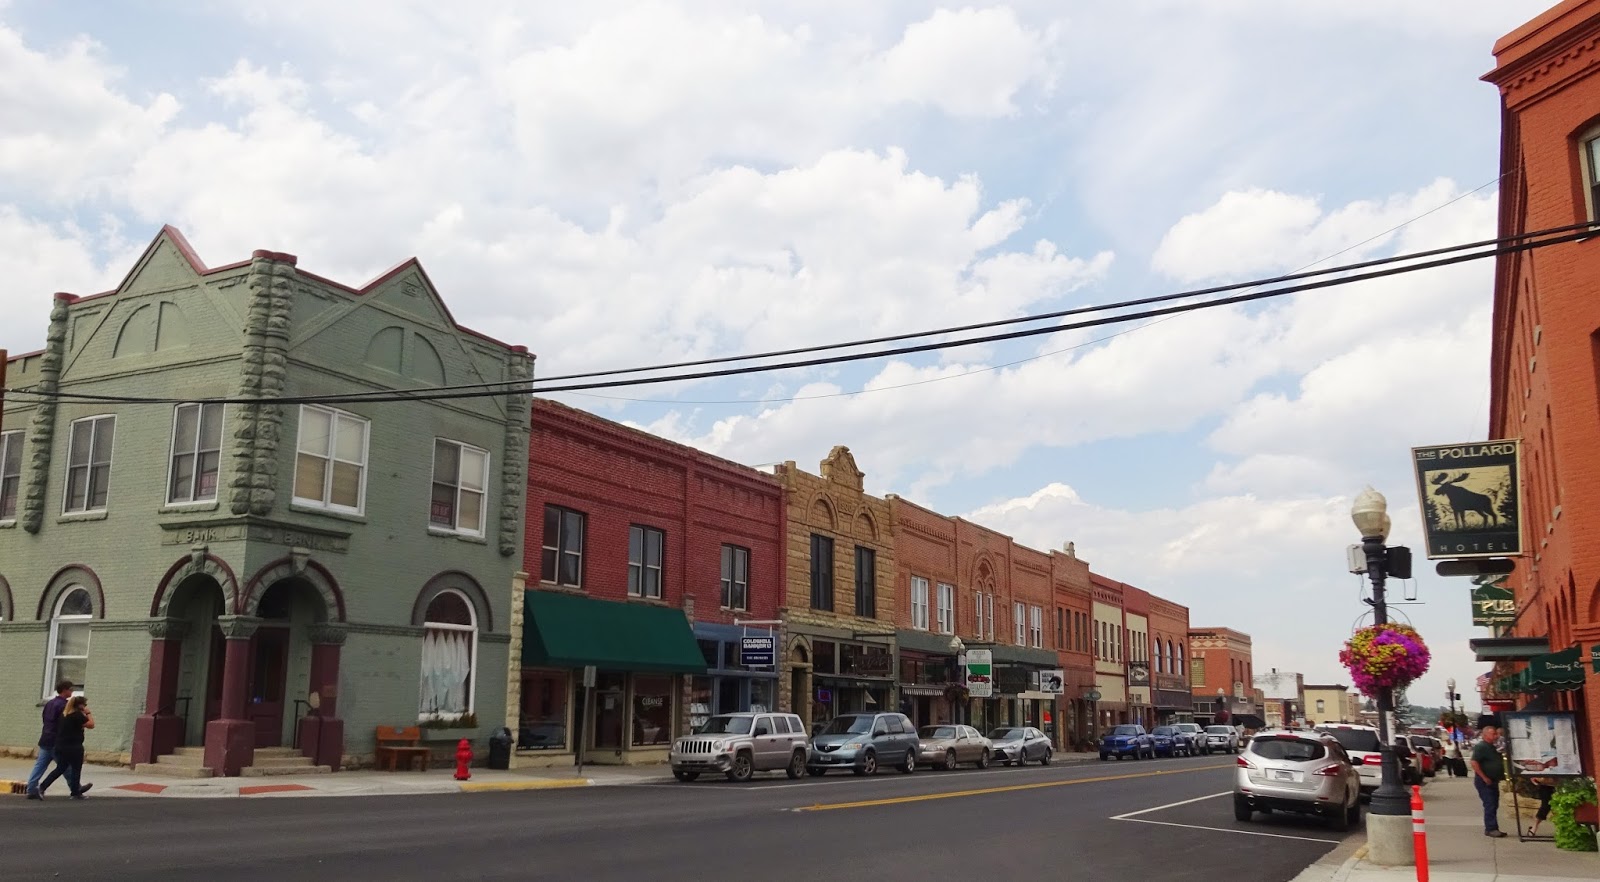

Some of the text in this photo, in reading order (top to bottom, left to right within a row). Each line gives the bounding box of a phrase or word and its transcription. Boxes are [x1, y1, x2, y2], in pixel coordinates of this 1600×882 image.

[1440, 444, 1515, 459] POLLARD
[186, 530, 216, 541] BANK
[1440, 543, 1508, 552] HOTEL
[1482, 600, 1515, 611] PUB
[1545, 662, 1571, 671] Dining
